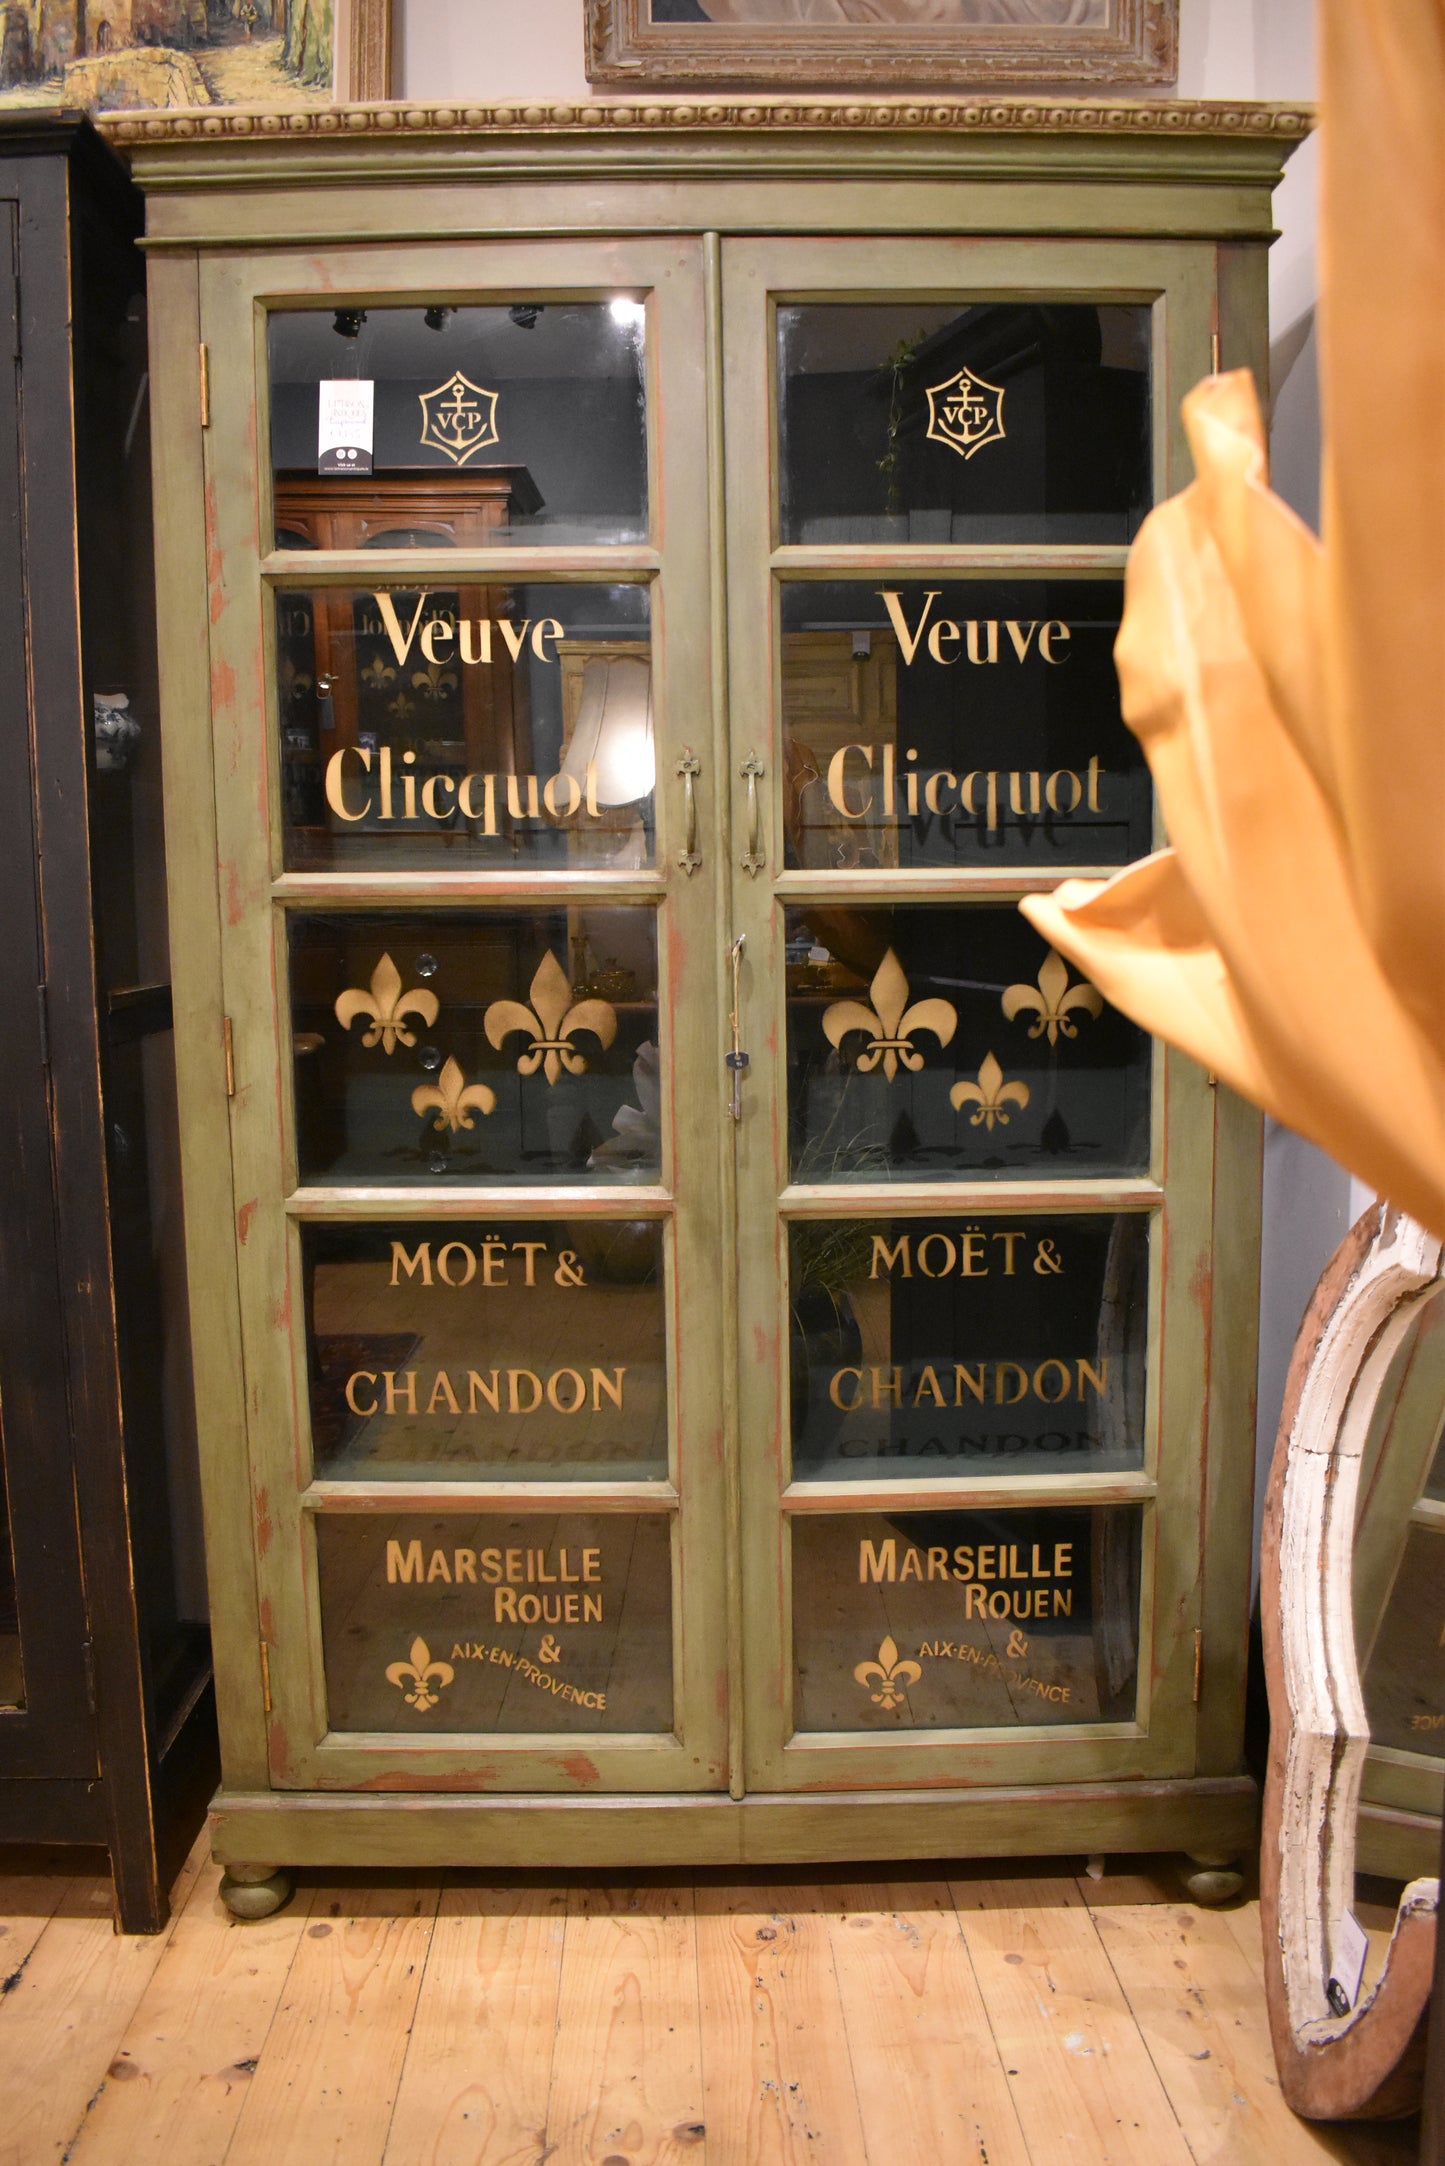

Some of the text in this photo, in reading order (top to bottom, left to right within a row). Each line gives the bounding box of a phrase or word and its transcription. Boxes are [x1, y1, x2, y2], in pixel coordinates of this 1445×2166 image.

[435, 412, 482, 431] VCP
[942, 407, 988, 425] VCP
[374, 592, 564, 666] Veuve
[876, 590, 1071, 667] Veuve
[325, 747, 608, 836] Clicquot
[827, 744, 1106, 832] Clicquot
[389, 1235, 588, 1287] MOËT &
[869, 1225, 1064, 1279] MOËT &
[345, 1367, 627, 1416] CHANDON
[830, 1357, 1110, 1412] CHANDON
[386, 1540, 601, 1584] MARSEILLE
[860, 1538, 1073, 1583] MARSEILLE
[494, 1586, 603, 1624] ROUEN
[965, 1583, 1072, 1620] ROUEN
[538, 1634, 561, 1664] &
[1006, 1629, 1029, 1658] &
